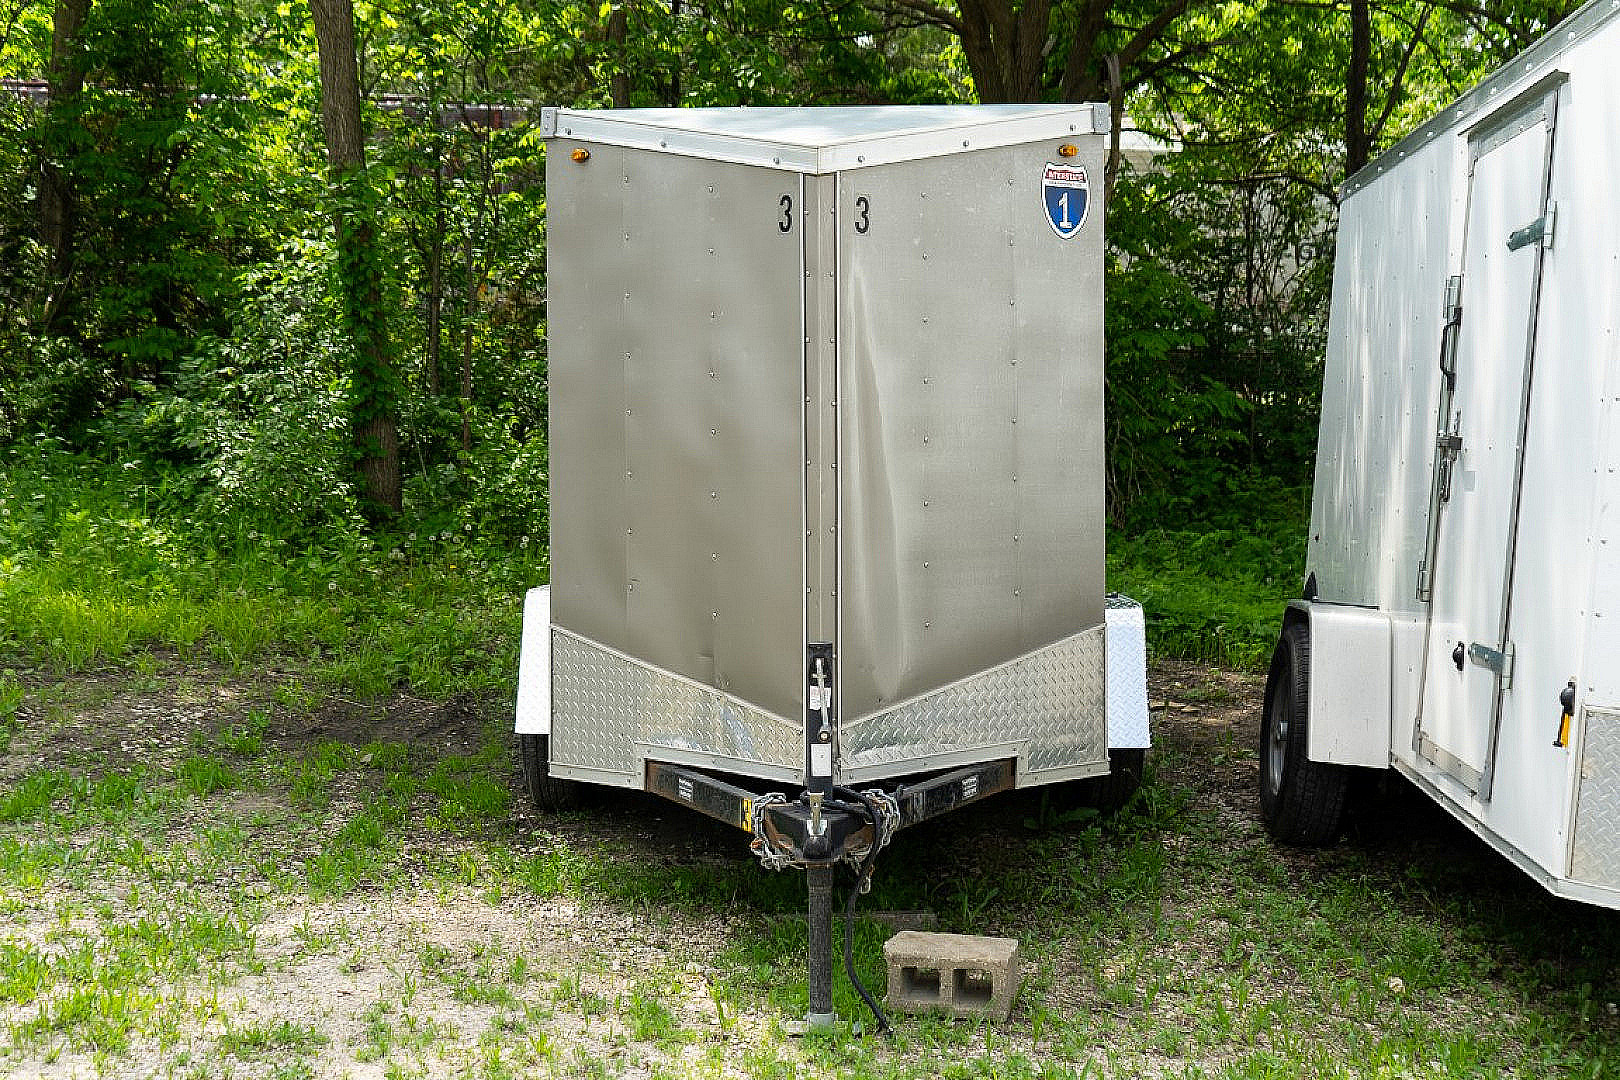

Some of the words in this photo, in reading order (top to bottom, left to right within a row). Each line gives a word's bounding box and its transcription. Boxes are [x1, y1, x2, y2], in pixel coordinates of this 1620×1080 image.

[779, 195, 792, 232] 3
[855, 196, 869, 233] 3
[1058, 192, 1072, 229] 1
